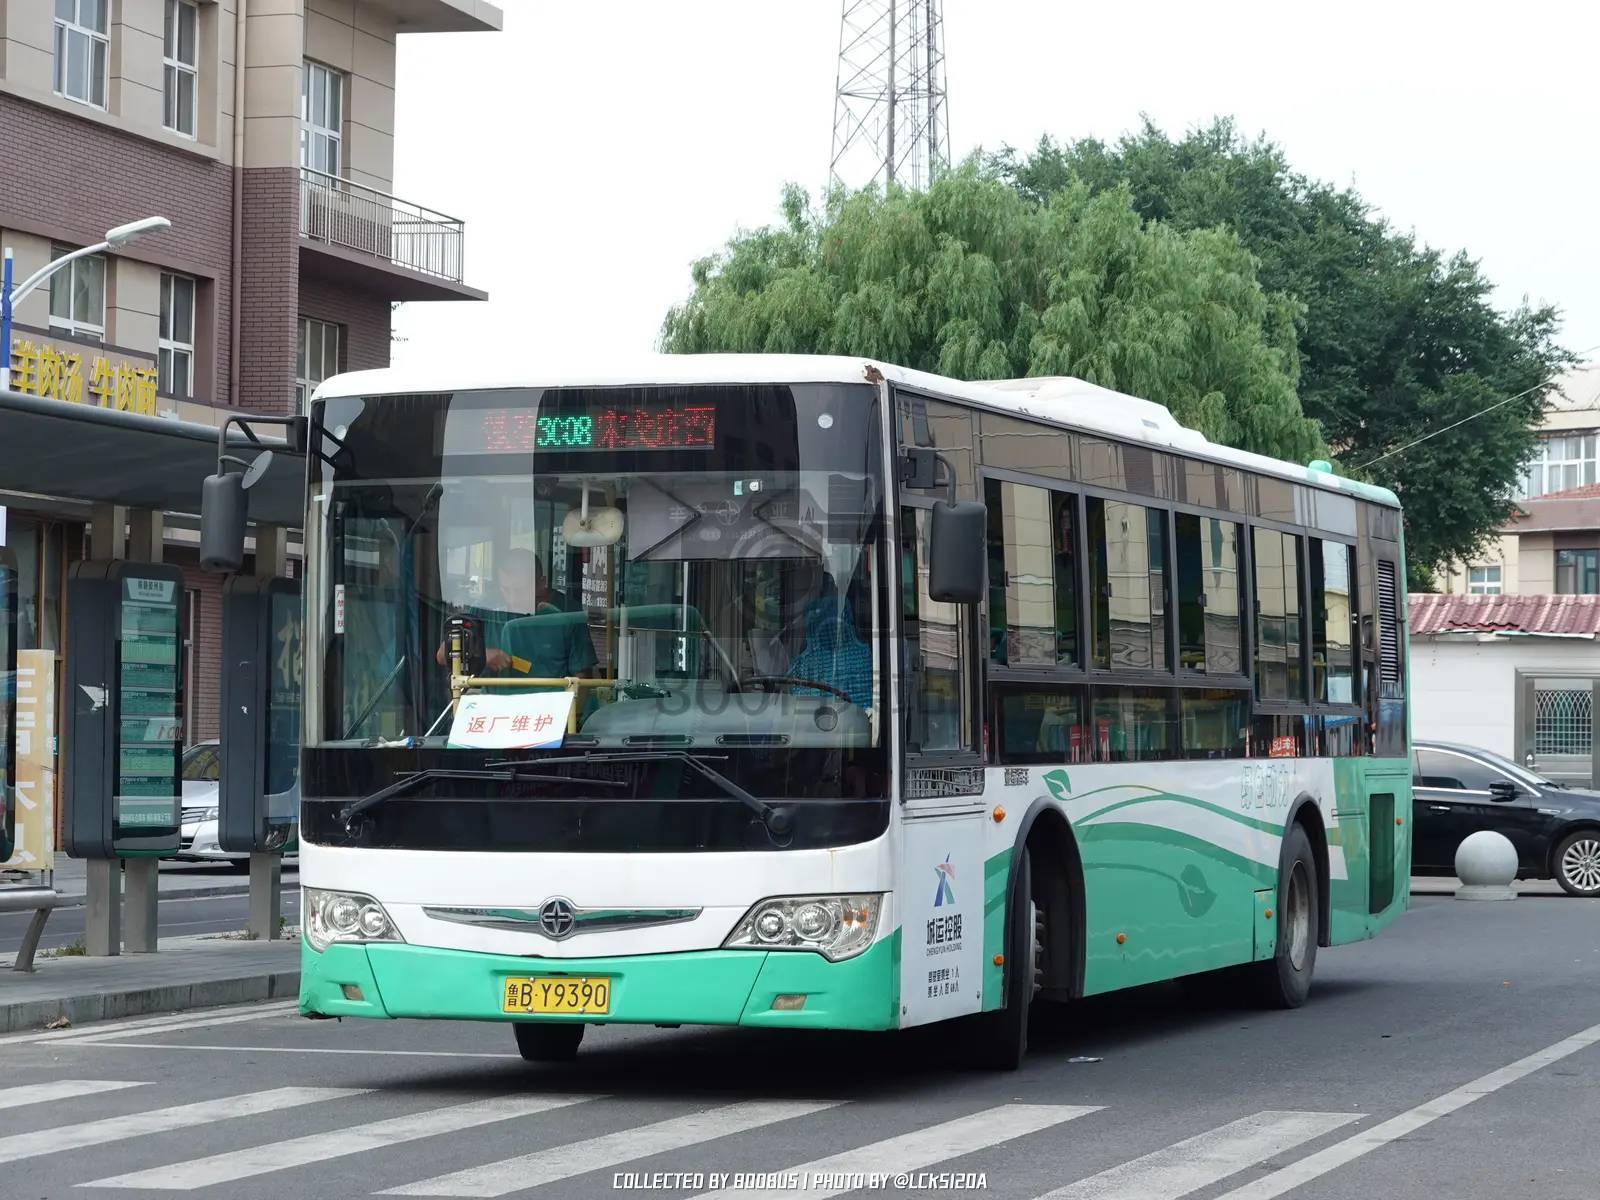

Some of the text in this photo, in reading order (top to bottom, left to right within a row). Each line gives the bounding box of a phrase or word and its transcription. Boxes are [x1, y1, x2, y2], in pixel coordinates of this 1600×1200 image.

[11, 340, 157, 416] 羊肉汤 牛肉面
[466, 714, 554, 734] 返厂维护
[926, 914, 962, 945] 城运控股
[946, 942, 962, 953] HOLDING
